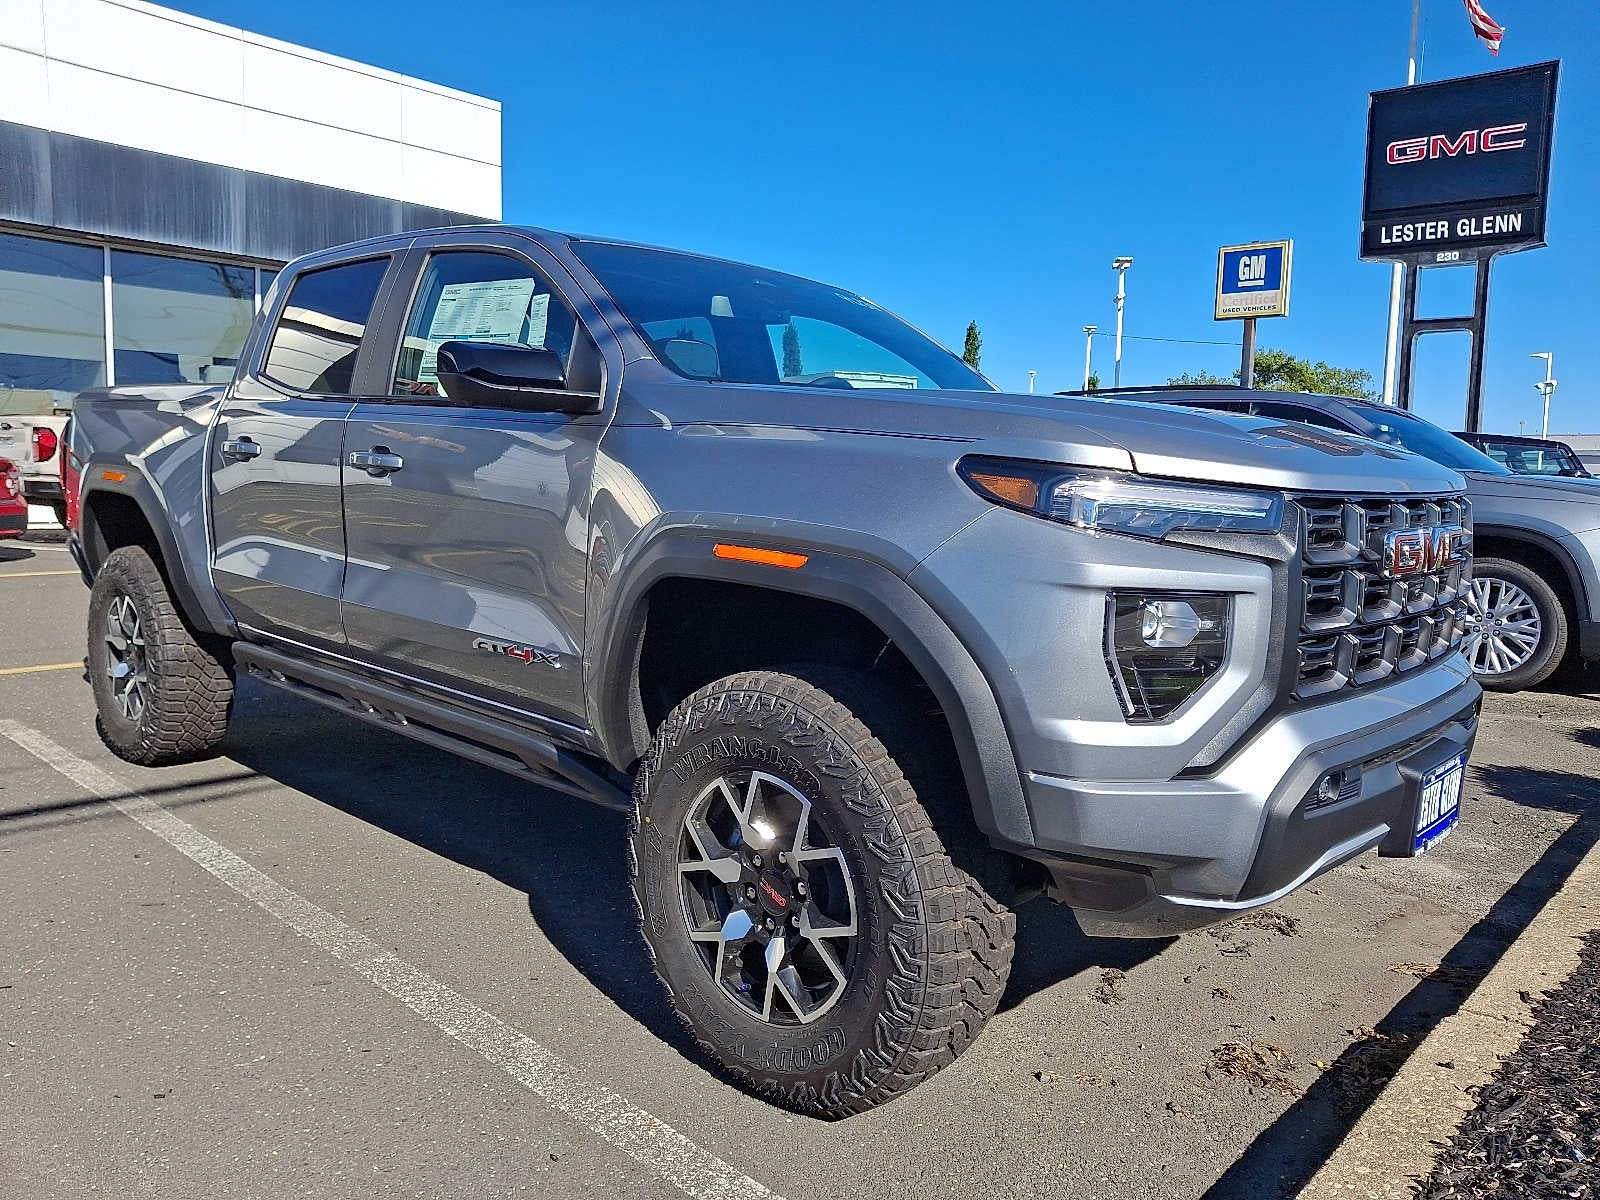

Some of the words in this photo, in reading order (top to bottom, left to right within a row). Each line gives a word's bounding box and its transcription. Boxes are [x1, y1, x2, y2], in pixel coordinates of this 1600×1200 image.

[1386, 123, 1528, 164] GMC
[1381, 220, 1449, 244] LESTER
[1456, 213, 1522, 237] GLENN
[1238, 255, 1267, 281] GM
[1436, 251, 1460, 262] 230
[1243, 304, 1277, 312] VEHICLES
[1388, 527, 1465, 577] GMC
